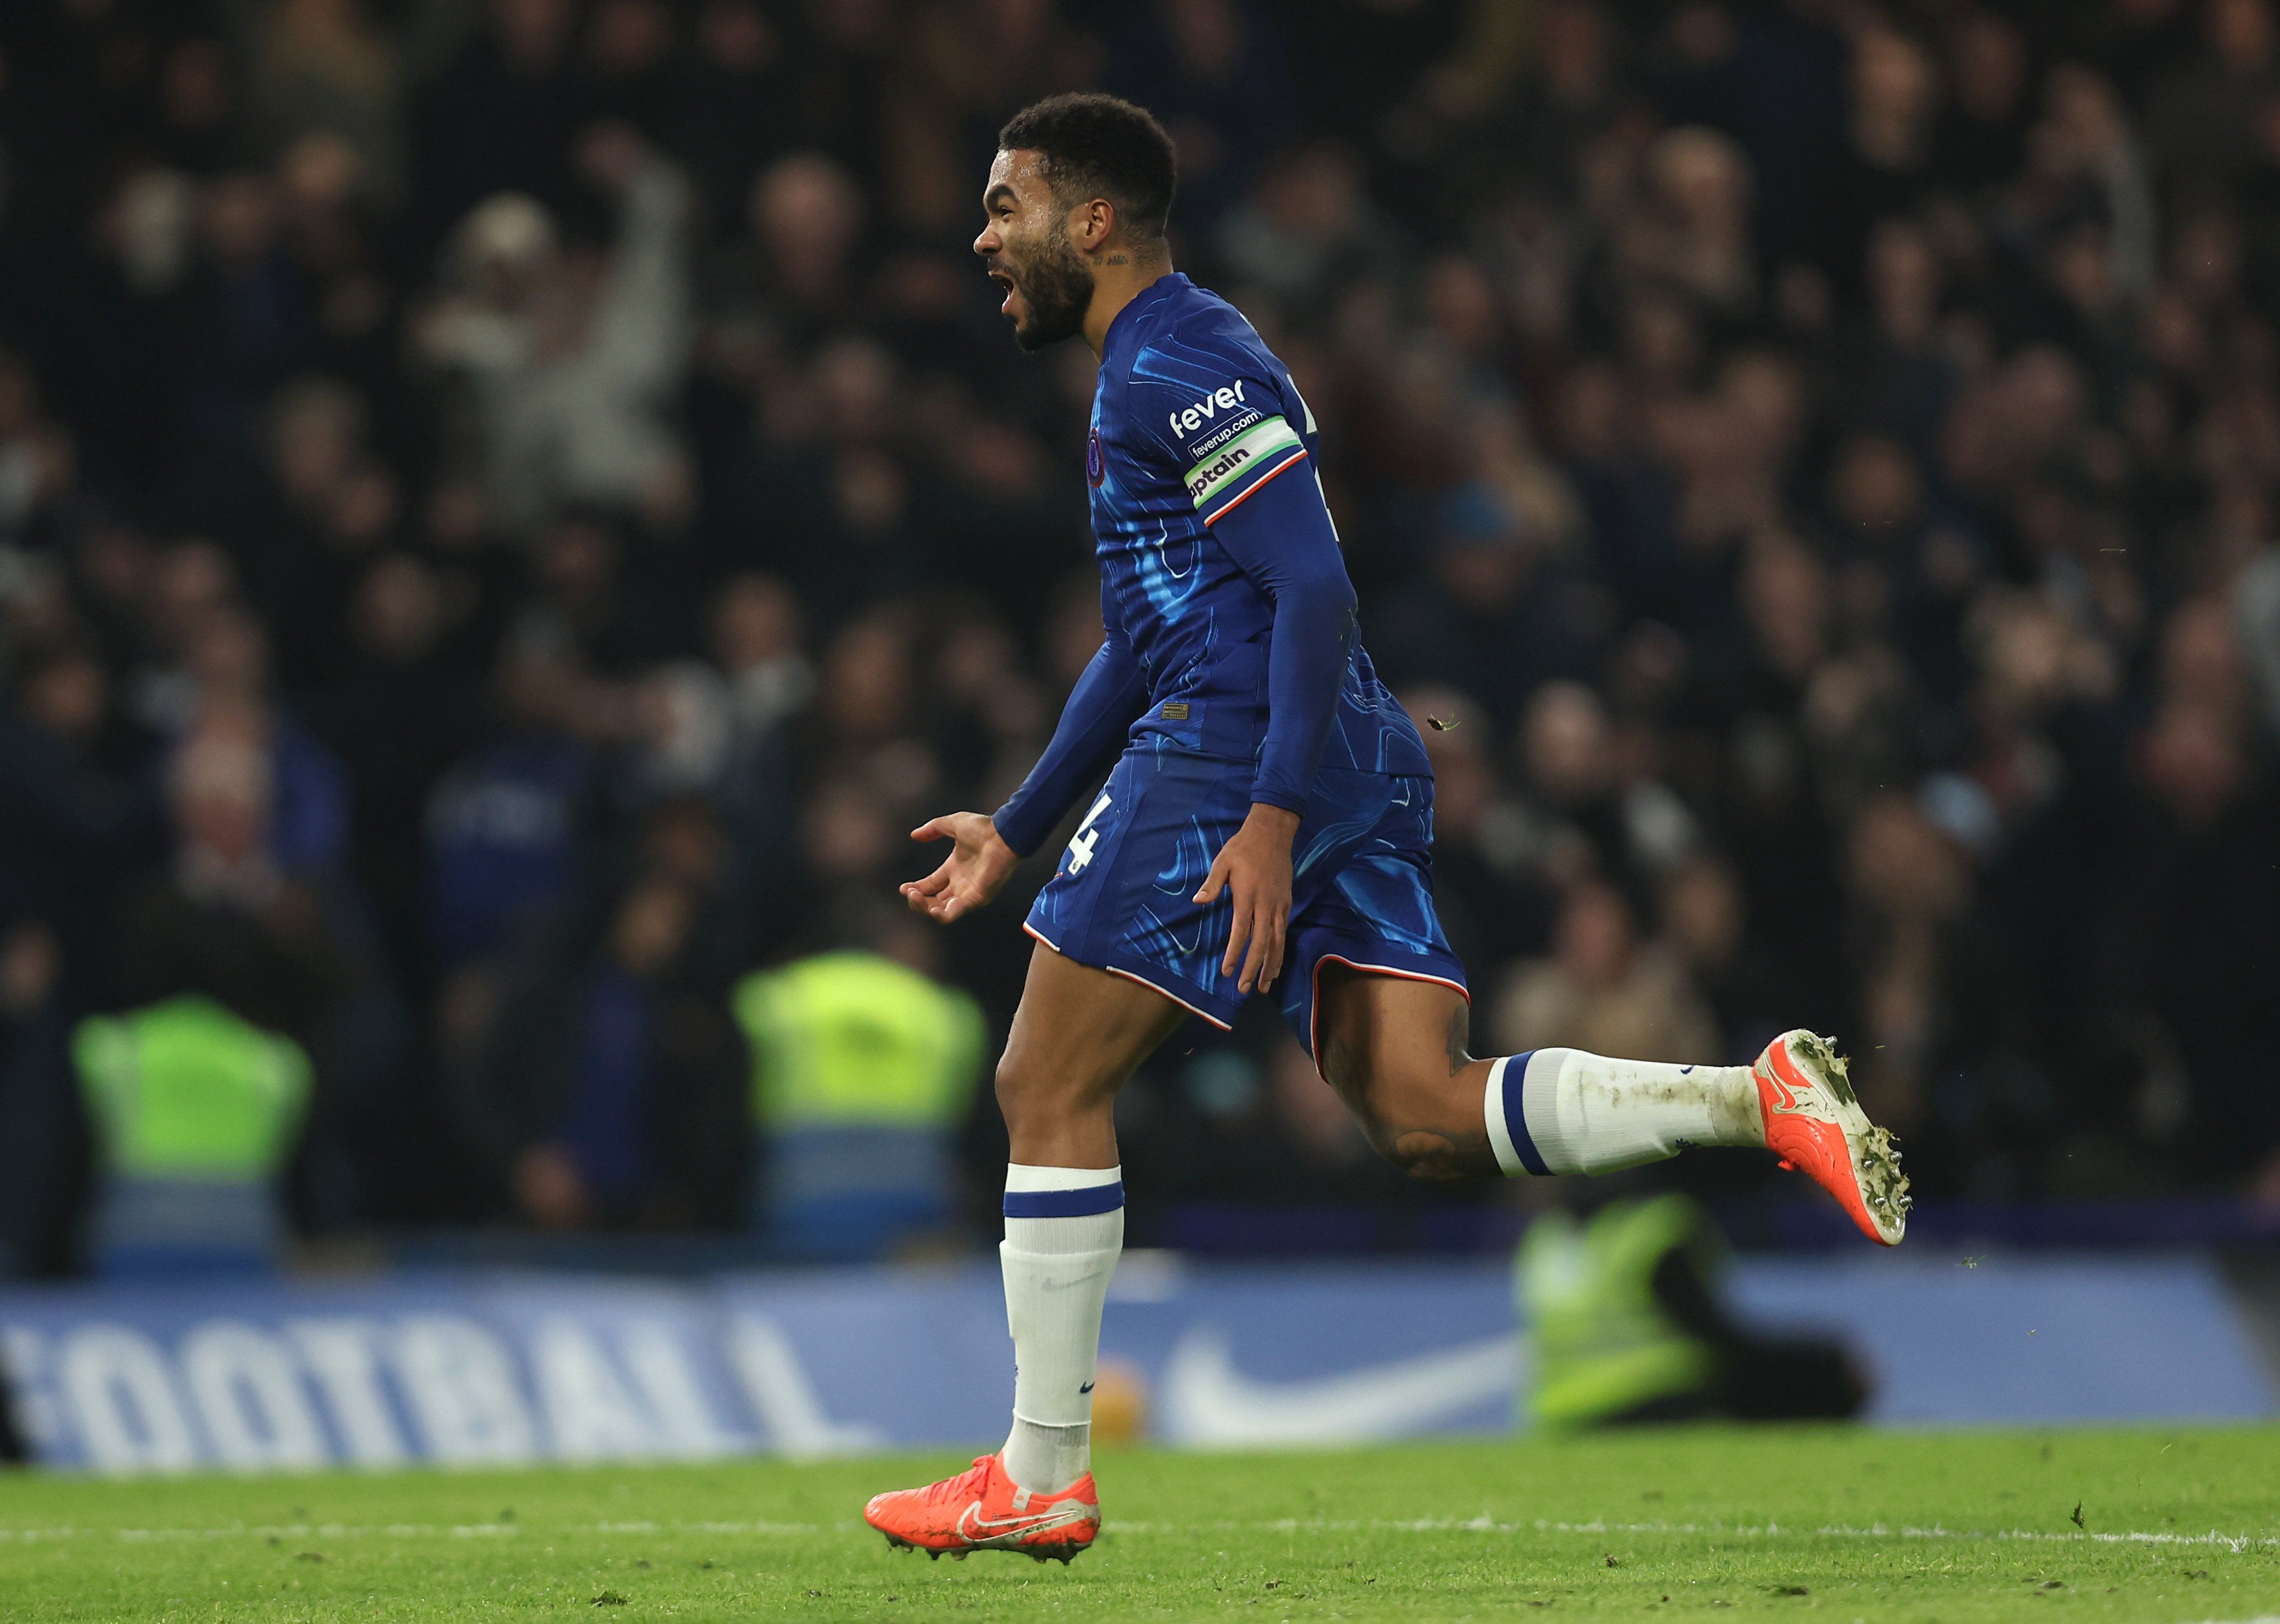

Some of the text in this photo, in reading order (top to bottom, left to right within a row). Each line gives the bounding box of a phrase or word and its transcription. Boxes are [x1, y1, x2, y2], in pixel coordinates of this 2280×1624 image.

[1170, 380, 1245, 439] fever
[1192, 412, 1259, 457] feverup.com
[1068, 793, 1112, 875] 4
